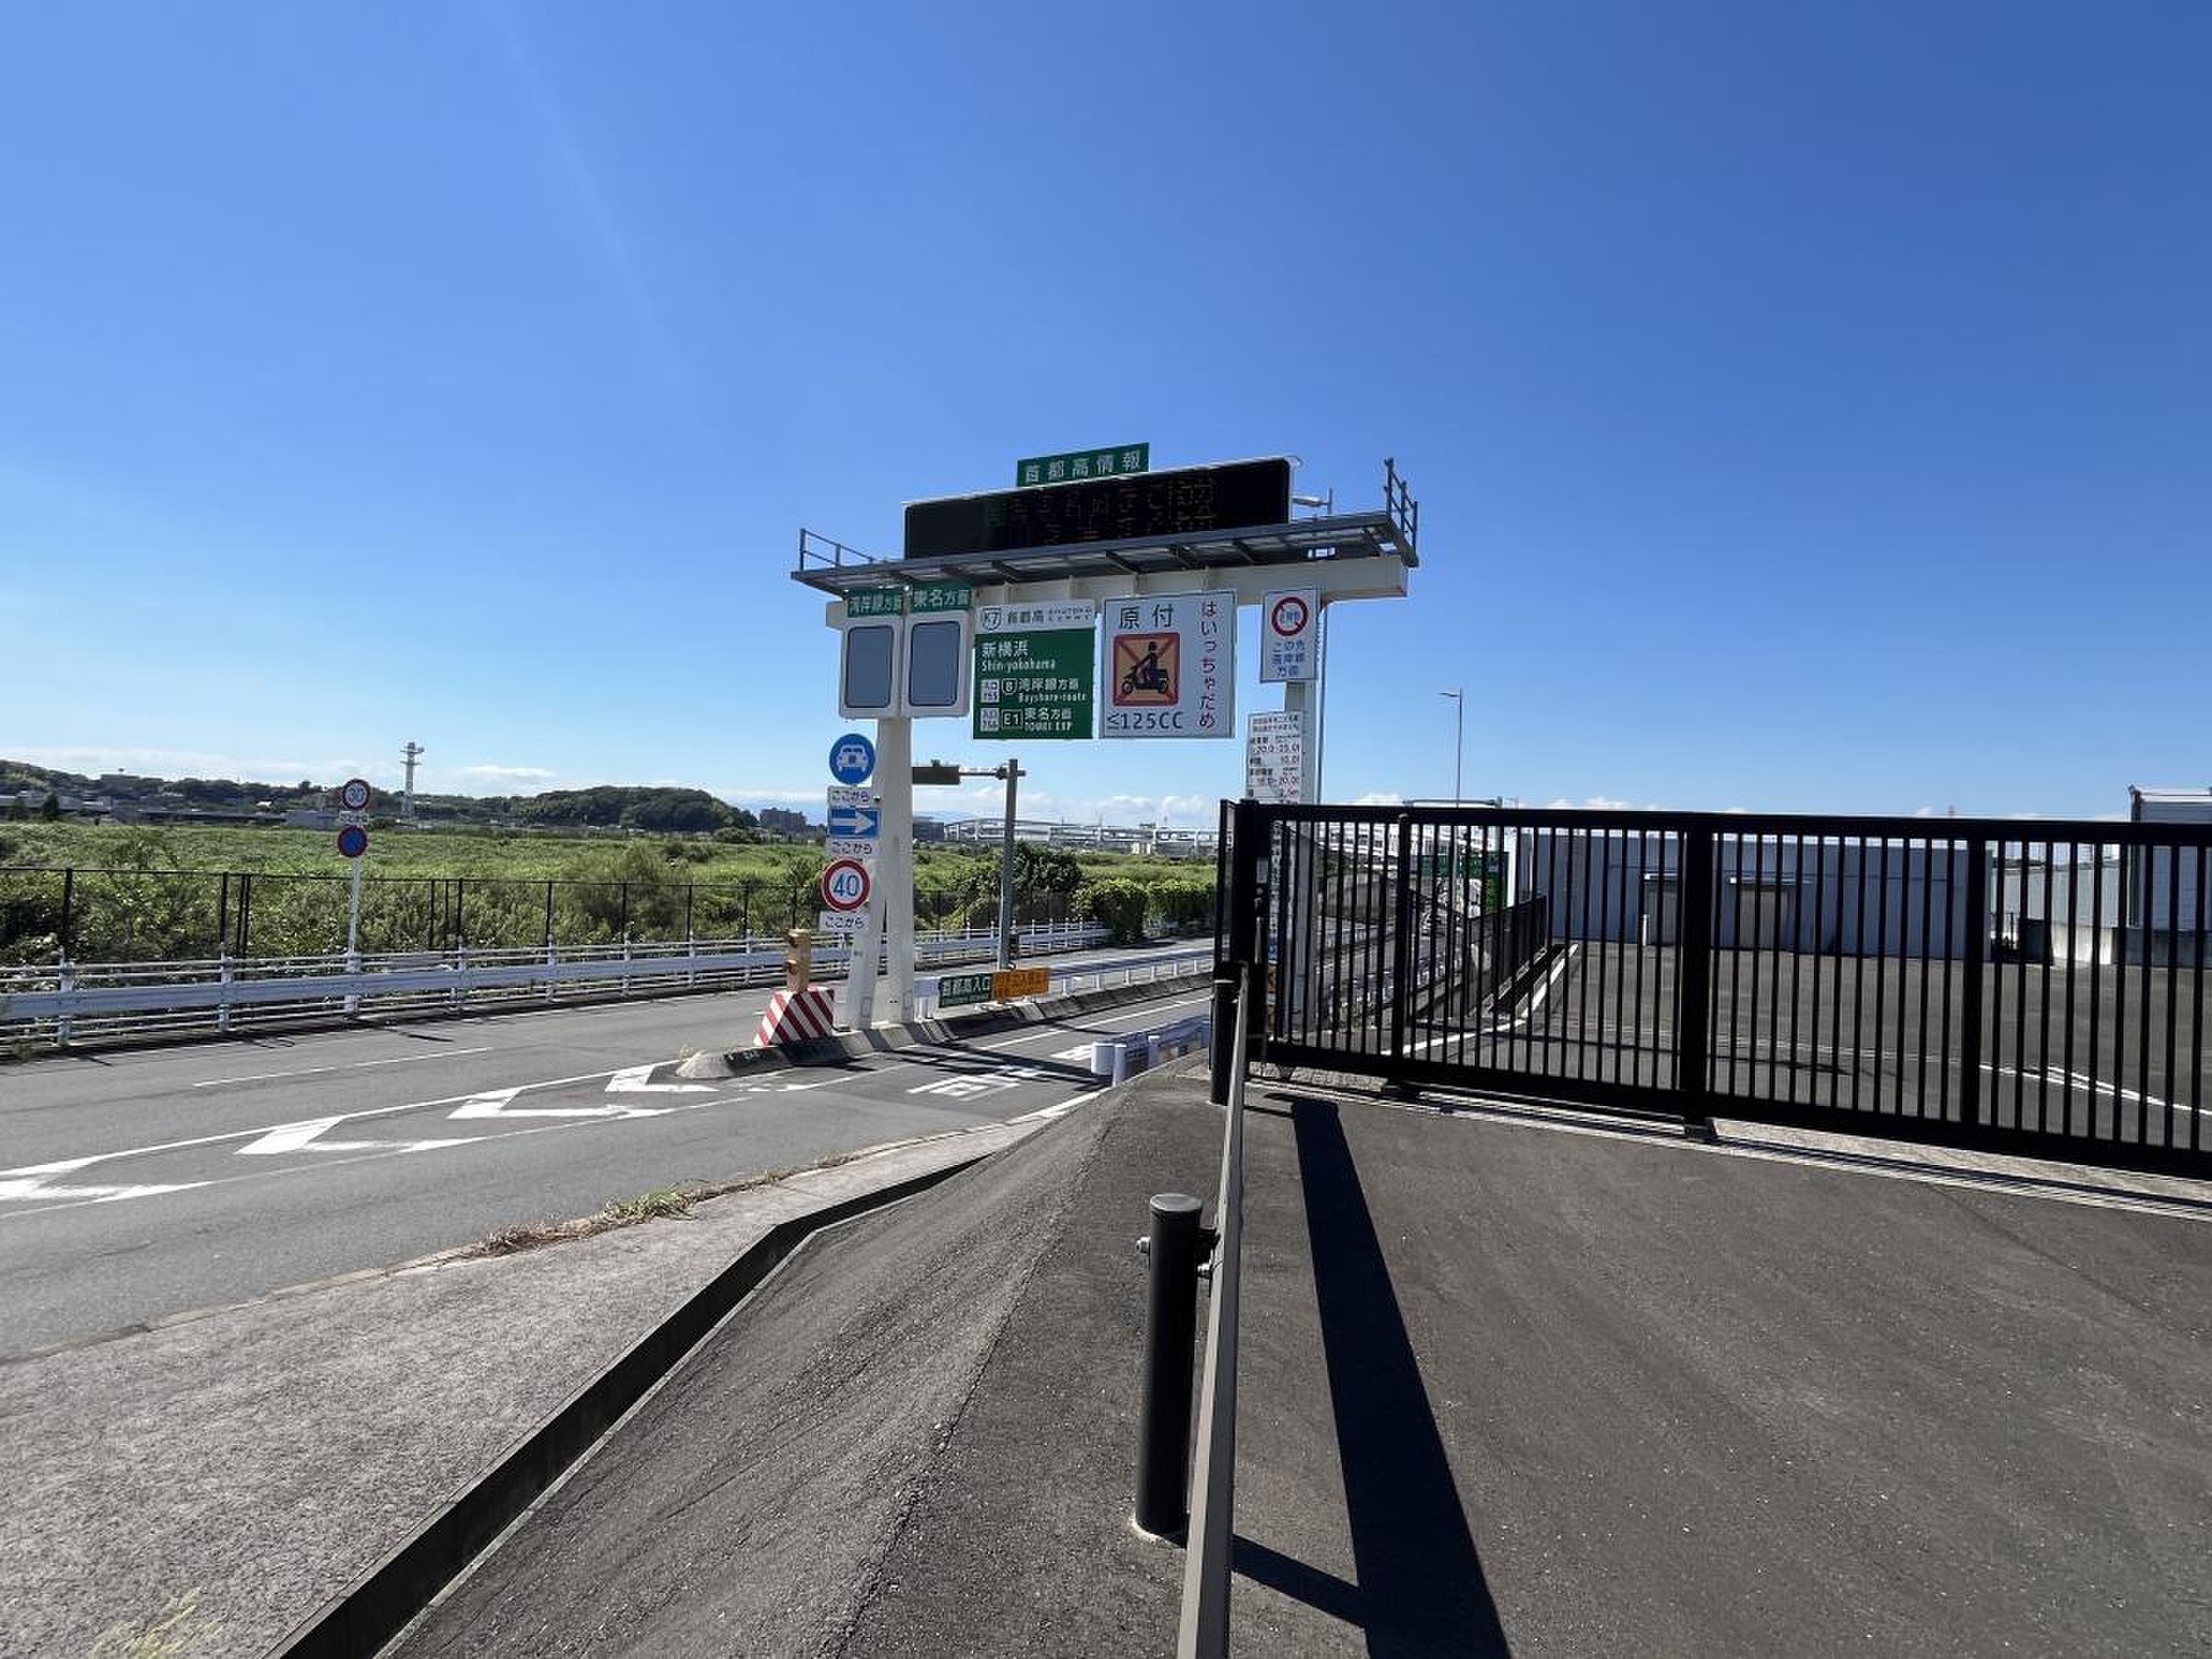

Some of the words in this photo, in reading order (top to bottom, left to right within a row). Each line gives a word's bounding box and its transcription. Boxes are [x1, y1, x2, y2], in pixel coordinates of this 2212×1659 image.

[1026, 450, 1141, 483] 首都高情報
[914, 589, 969, 606] 東名方面
[1119, 604, 1174, 629] 原付
[982, 640, 1029, 658] 新横浜
[1273, 640, 1304, 652] この先
[1199, 600, 1218, 729] はいっちゃだめ
[1003, 712, 1019, 725] E1
[1024, 707, 1072, 720] 東名方面
[831, 790, 870, 803] ここから
[831, 842, 872, 854] ここから
[832, 875, 860, 898] 40
[825, 916, 865, 929] ここから
